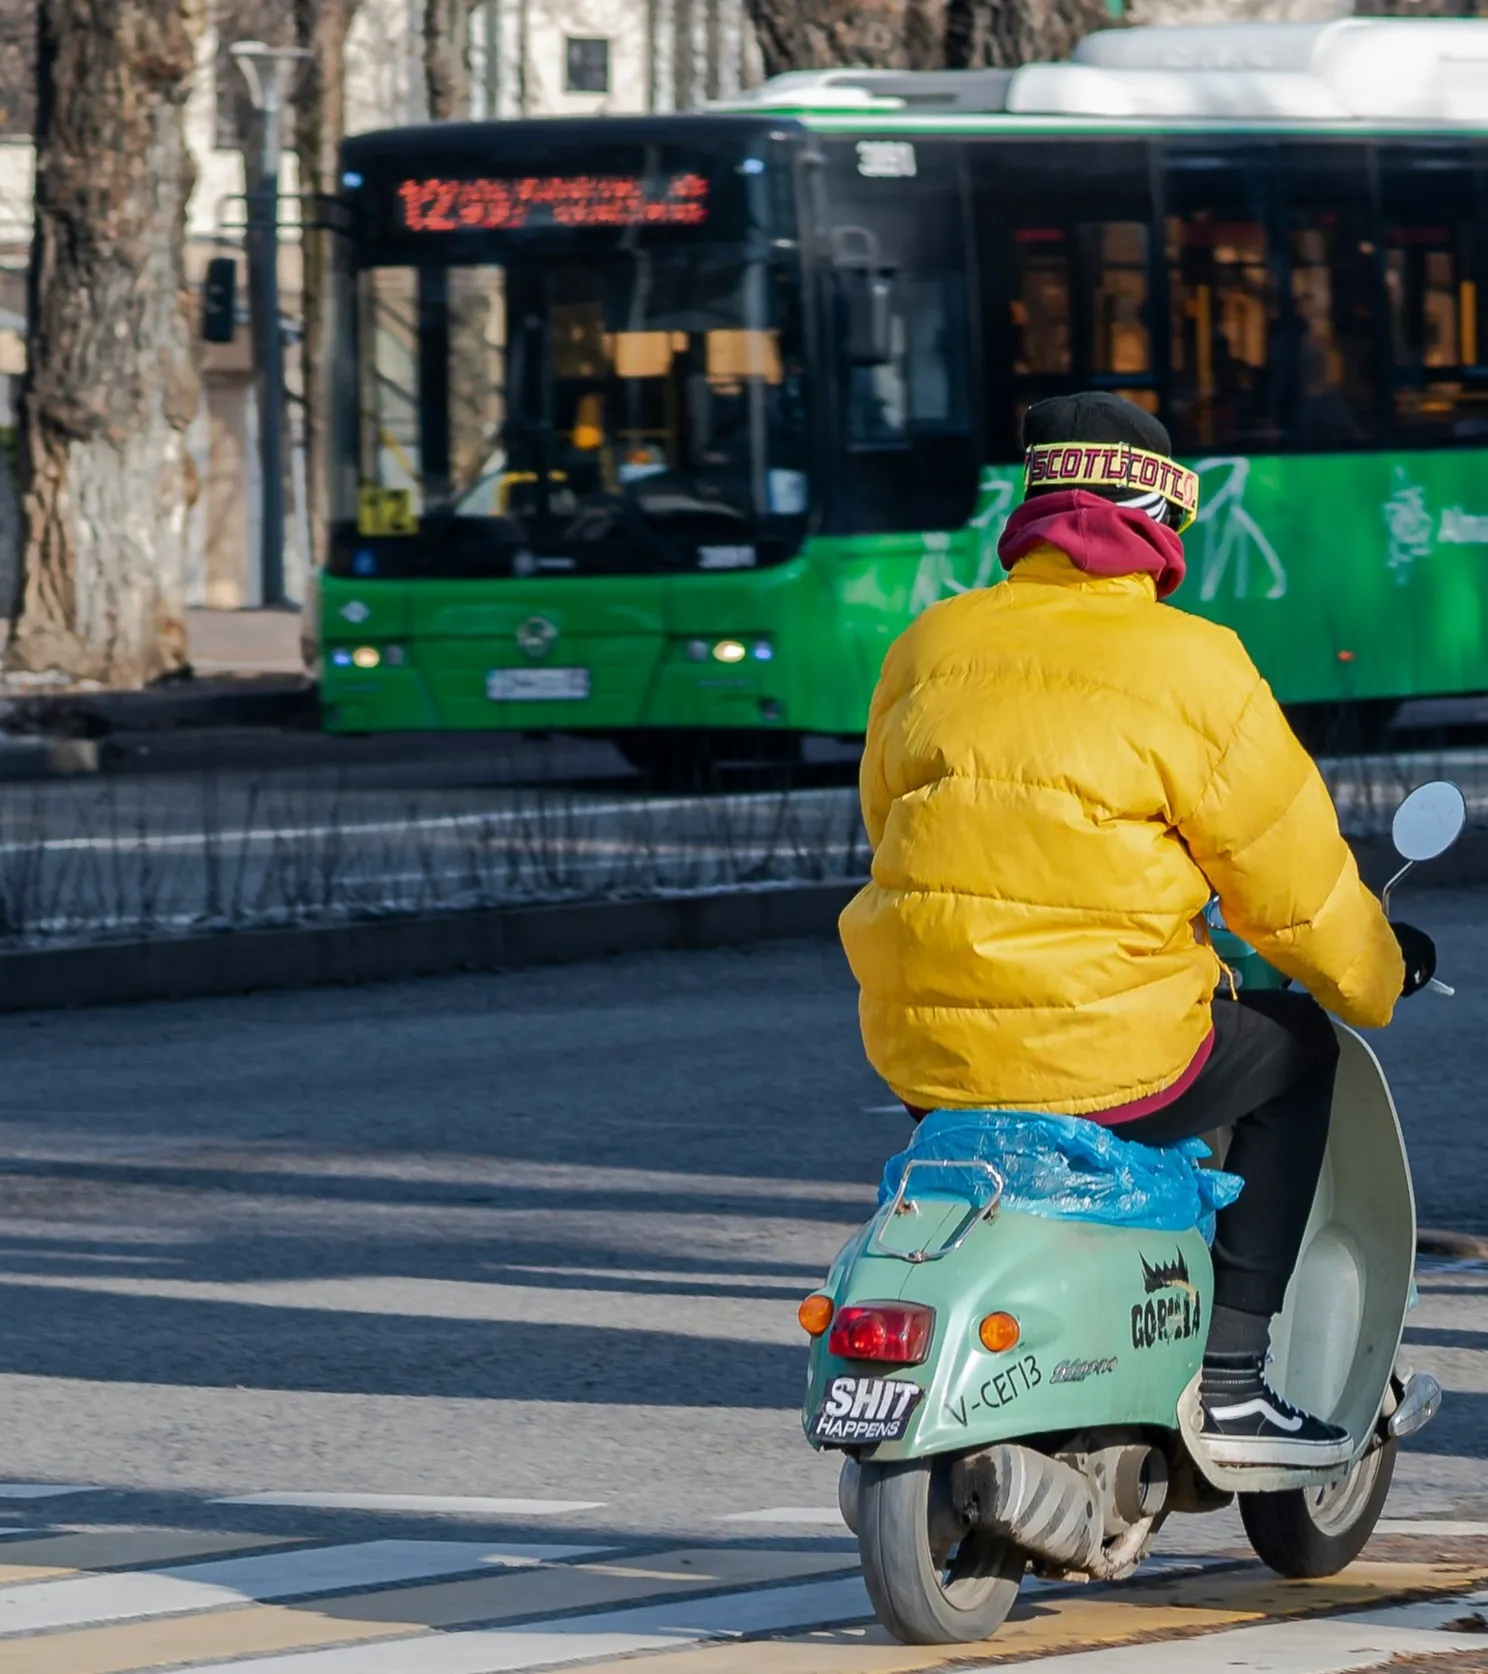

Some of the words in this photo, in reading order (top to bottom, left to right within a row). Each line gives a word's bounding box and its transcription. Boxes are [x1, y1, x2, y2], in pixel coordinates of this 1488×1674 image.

[1032, 448, 1119, 480] SCOTT
[825, 1377, 920, 1420] SHIT
[816, 1413, 900, 1439] HAPPENS
